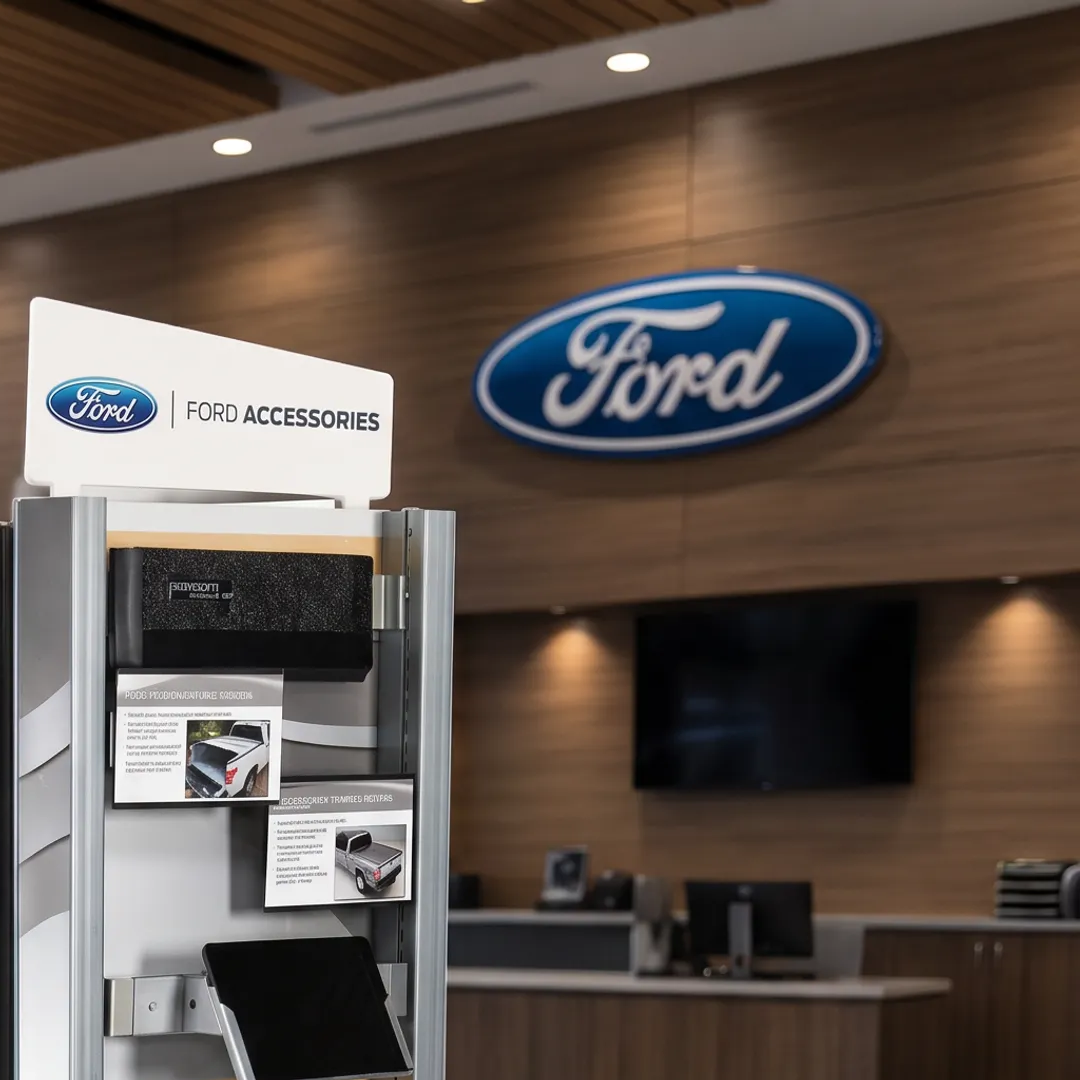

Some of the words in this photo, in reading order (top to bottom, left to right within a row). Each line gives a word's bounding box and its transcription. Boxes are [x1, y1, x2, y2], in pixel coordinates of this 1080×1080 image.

[542, 300, 791, 428] Ford
[69, 386, 136, 423] Ford
[187, 401, 238, 423] FORD
[243, 405, 381, 432] ACCESSORIES
